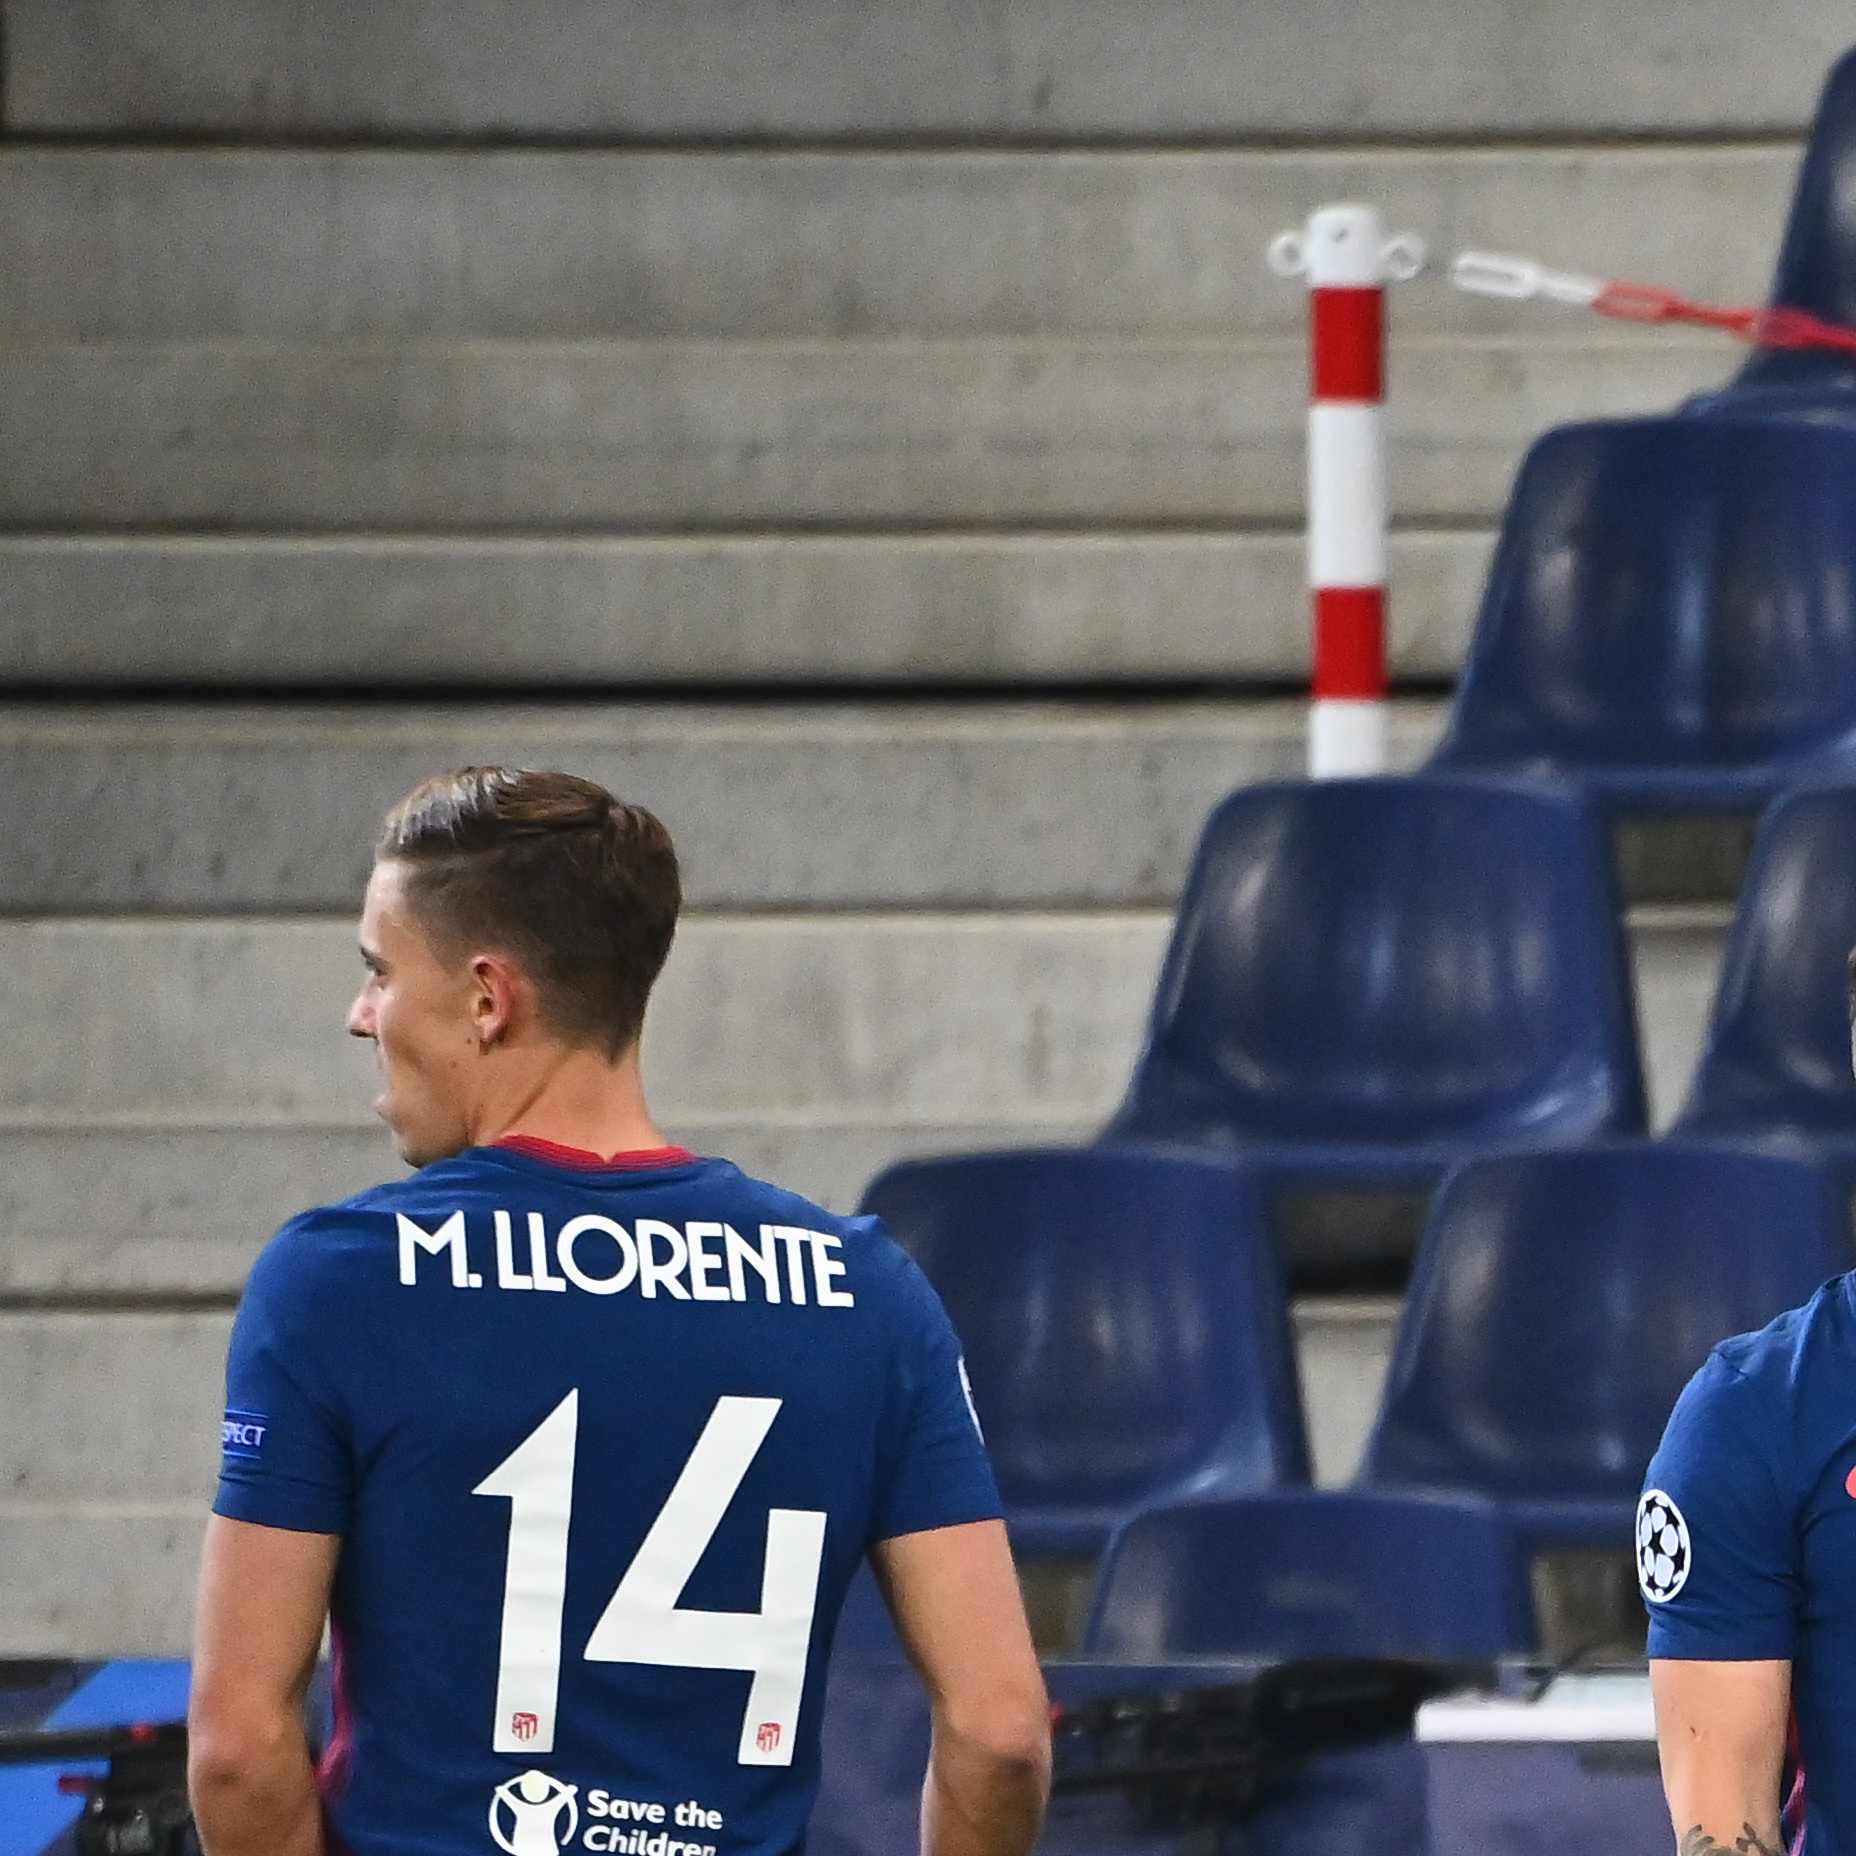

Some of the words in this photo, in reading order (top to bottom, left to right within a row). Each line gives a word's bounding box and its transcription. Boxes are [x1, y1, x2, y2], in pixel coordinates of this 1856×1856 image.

[395, 1210, 482, 1289] M.
[493, 1211, 855, 1308] LLORENTE
[471, 1387, 828, 1766] 14
[586, 1788, 666, 1824] Save
[674, 1800, 724, 1830] the
